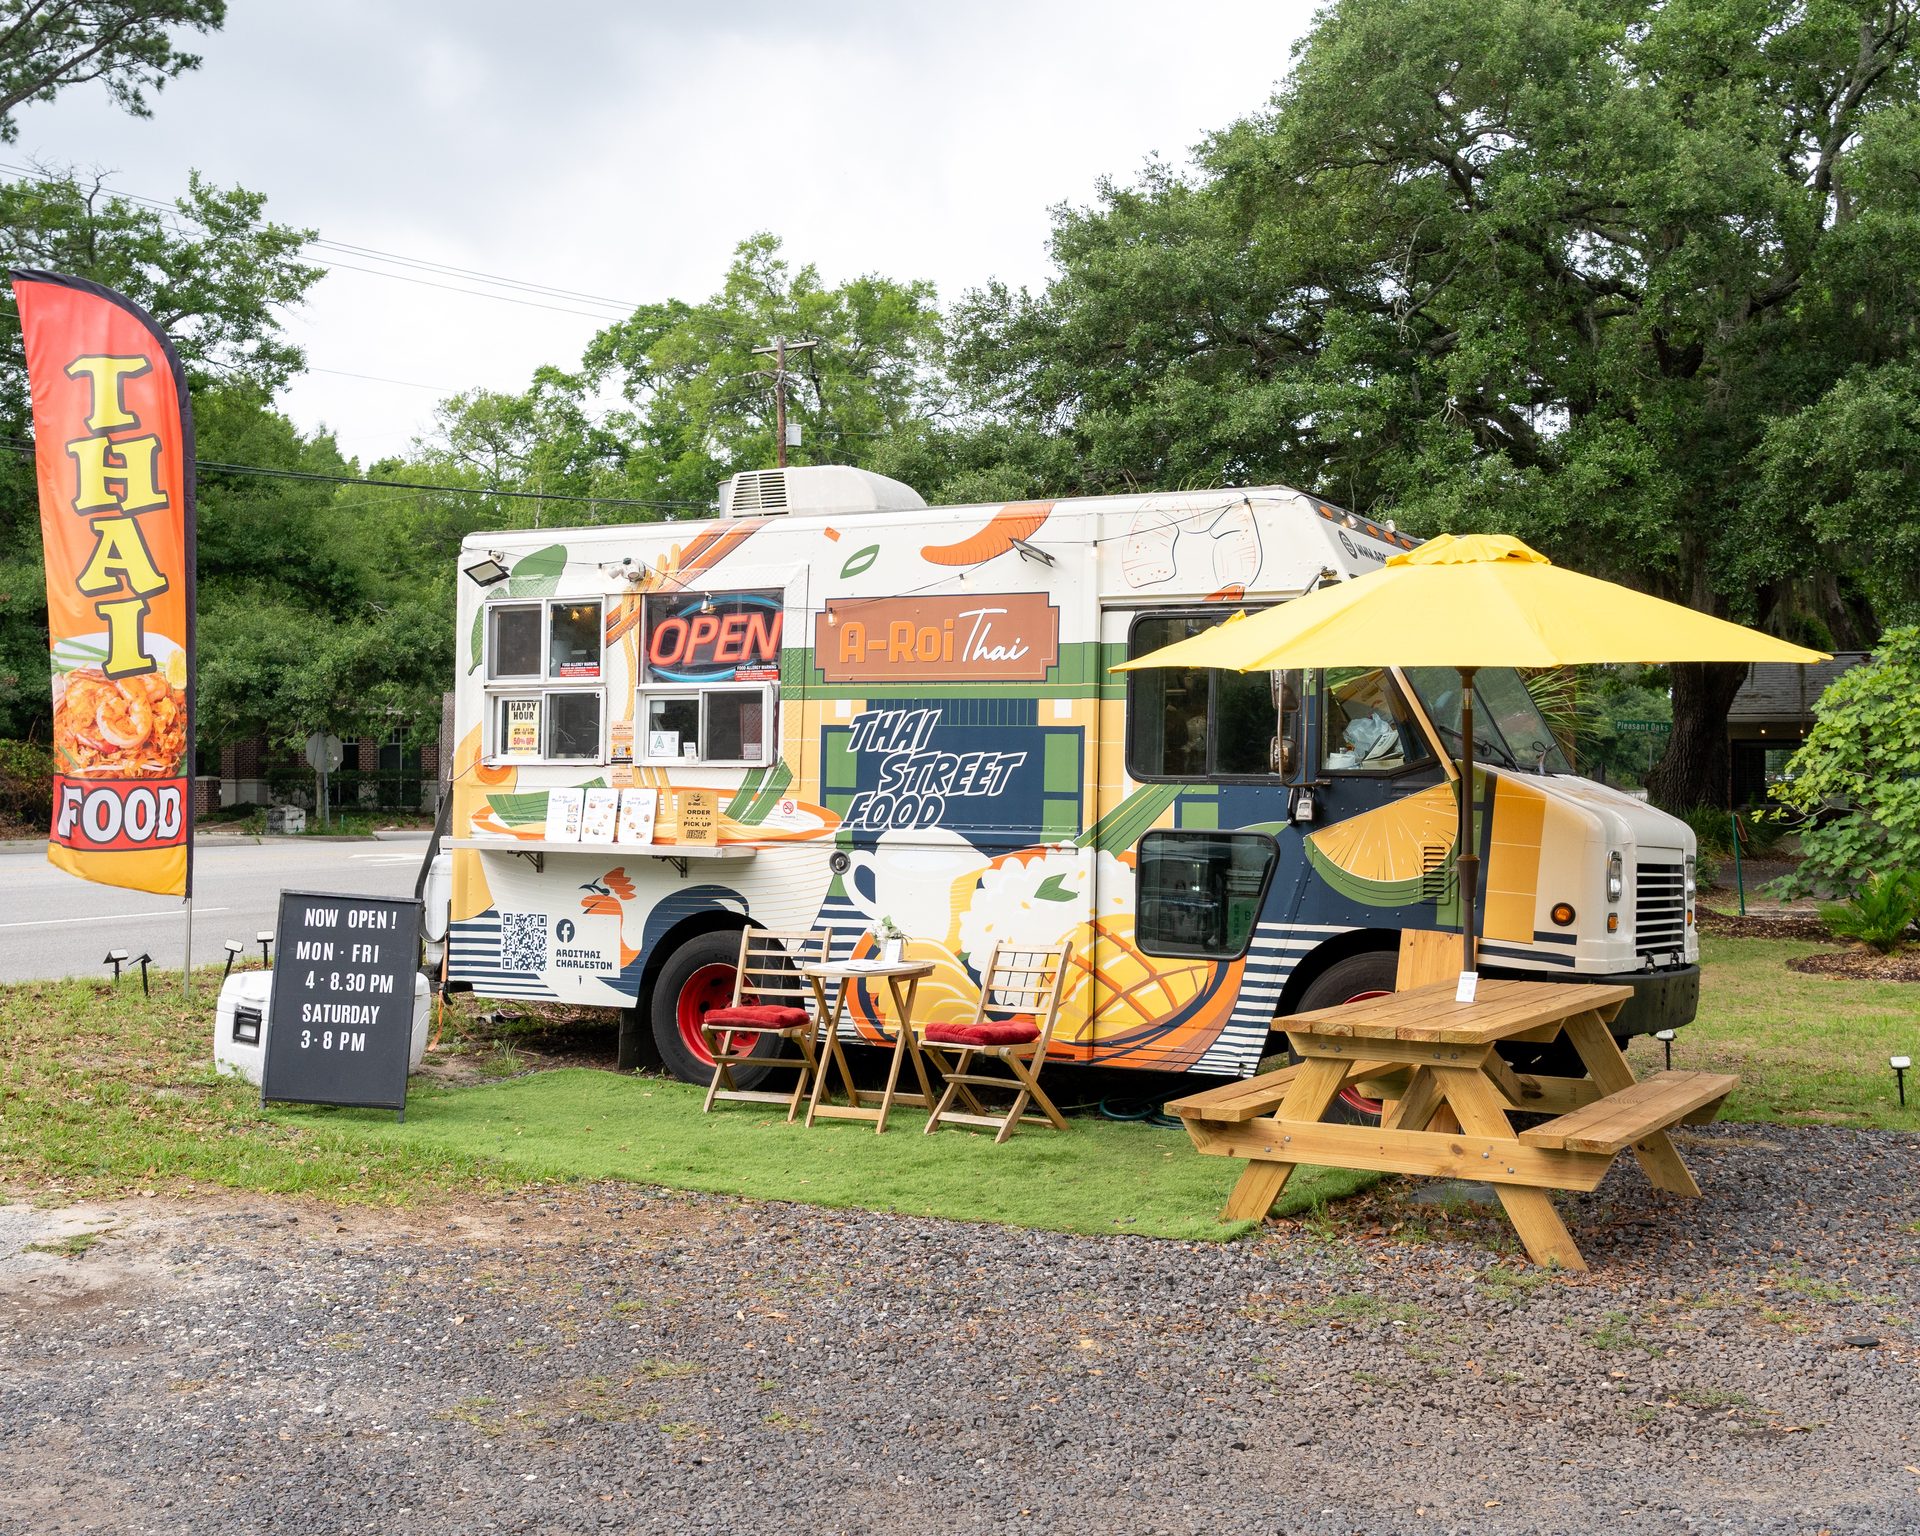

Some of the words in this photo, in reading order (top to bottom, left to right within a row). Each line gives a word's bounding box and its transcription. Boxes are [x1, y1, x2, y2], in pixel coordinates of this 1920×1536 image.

[63, 353, 170, 682] THAI
[649, 611, 784, 667] OPEN
[839, 618, 954, 663] A-Roi
[958, 607, 1030, 662] Thai
[511, 702, 537, 711] HAPPY
[513, 711, 534, 720] HOUR
[846, 708, 943, 753] THAI
[1617, 721, 1649, 730] Pleasant
[1651, 722, 1669, 732] Oaks
[877, 750, 1028, 797] STREET
[56, 782, 182, 844] FOOD
[840, 790, 946, 832] FOOD
[686, 829, 708, 839] HERE
[304, 908, 339, 928] NOW
[296, 941, 334, 961] MON
[351, 944, 380, 963] FRI
[556, 949, 601, 959] AROITHAI
[556, 959, 613, 970] CHARLESTON
[369, 974, 394, 994] PM
[302, 1003, 381, 1025] SATURDAY
[339, 1031, 366, 1052] PM
